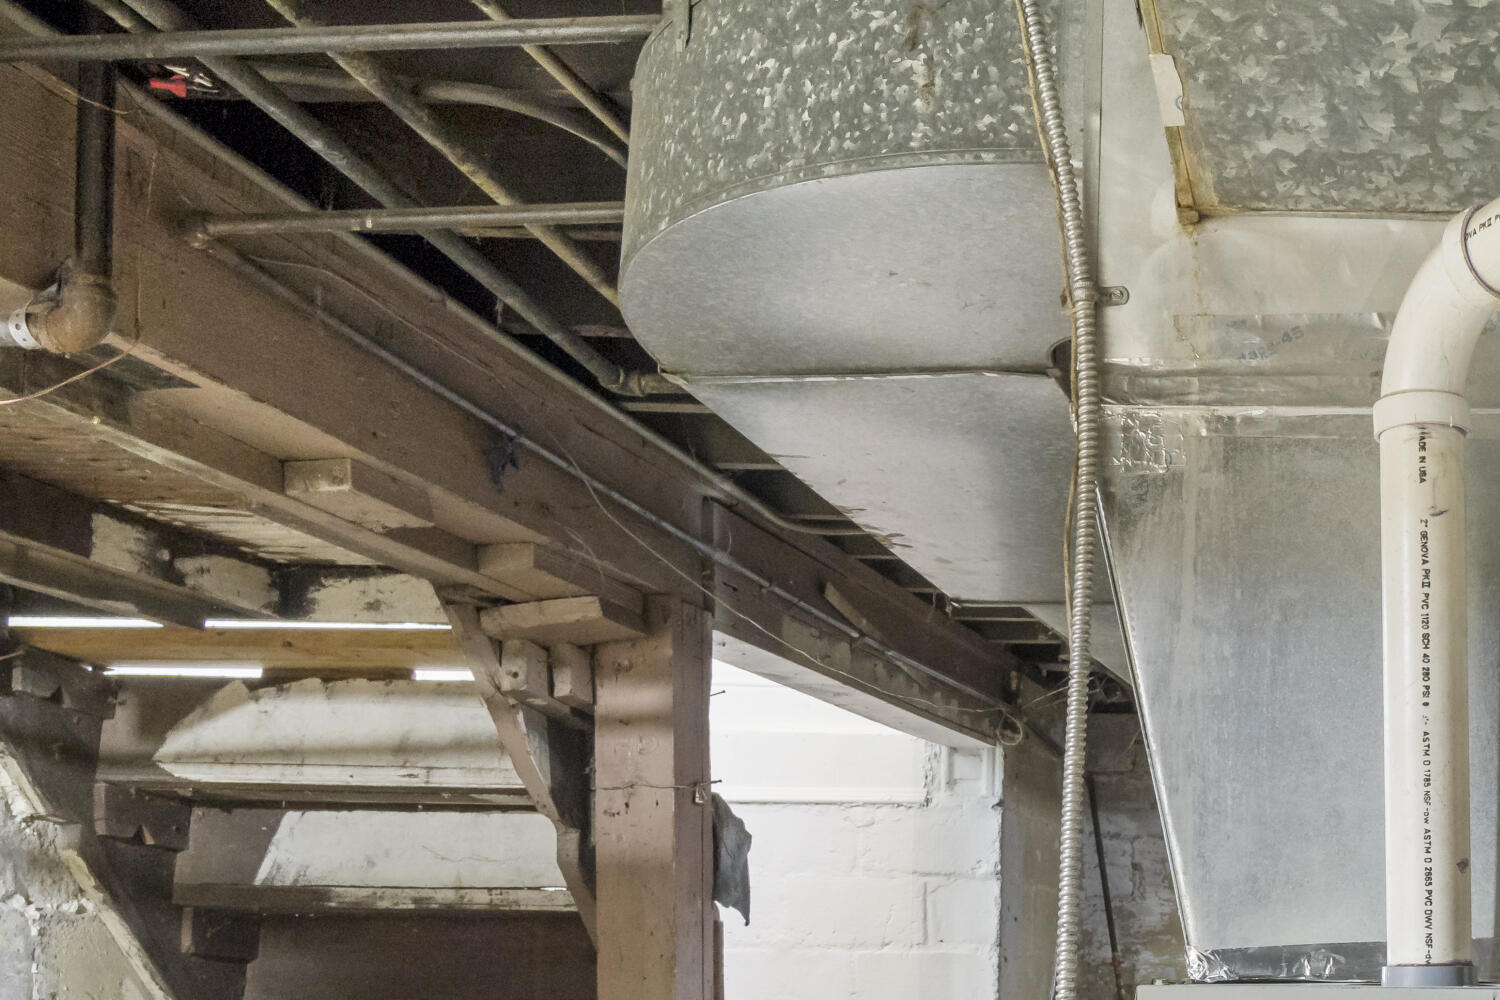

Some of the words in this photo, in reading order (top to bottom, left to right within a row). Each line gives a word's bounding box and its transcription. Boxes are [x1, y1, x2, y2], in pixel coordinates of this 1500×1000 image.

[1419, 467, 1427, 484] USA
[1420, 531, 1429, 565] GENOVA
[1421, 592, 1429, 610] PVC
[1421, 613, 1429, 630] 1120
[1422, 633, 1430, 650] SCH
[1422, 653, 1430, 664] 40
[1422, 667, 1430, 682] 280
[1422, 731, 1431, 757] ASTM
[1423, 769, 1431, 788] 1785
[1424, 828, 1432, 854] ASTM
[1424, 866, 1432, 887] 2665
[1425, 889, 1433, 906] PVC
